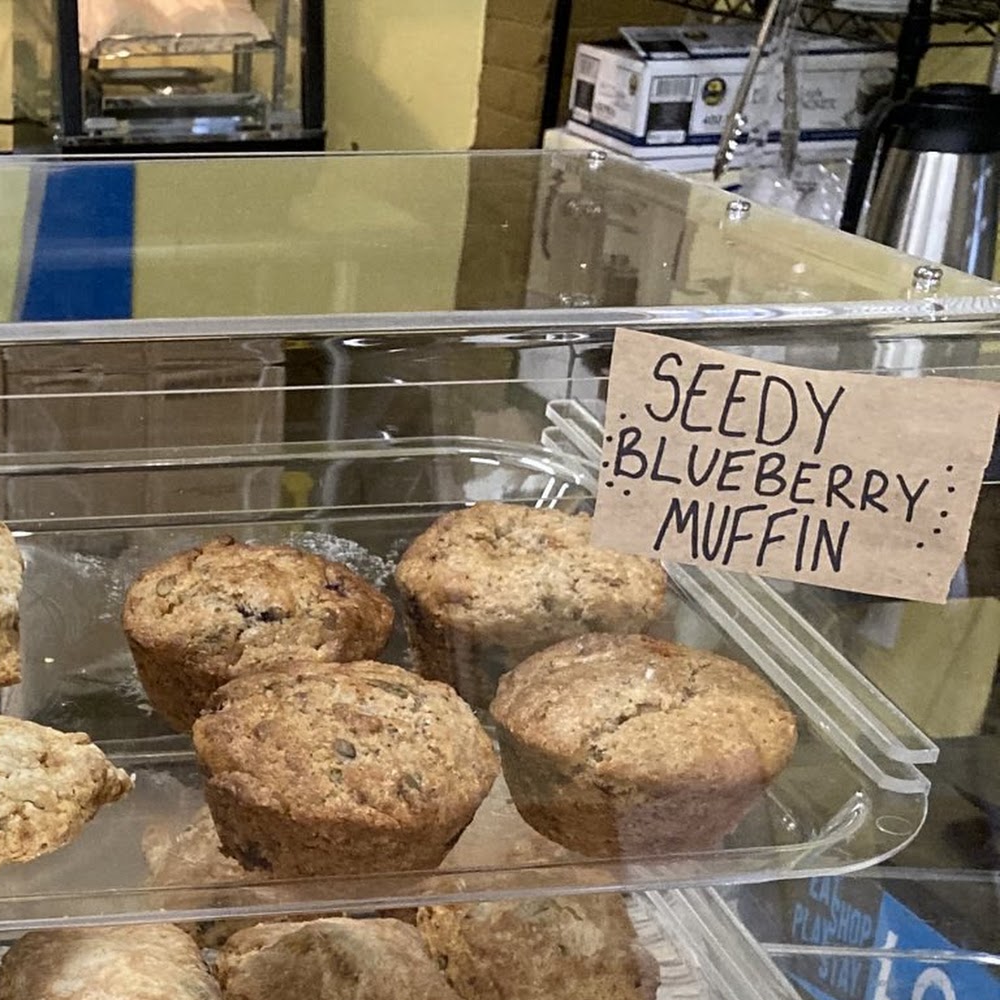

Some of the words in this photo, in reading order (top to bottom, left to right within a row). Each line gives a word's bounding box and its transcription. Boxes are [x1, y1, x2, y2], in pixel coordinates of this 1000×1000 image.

[645, 352, 845, 455] SEEDY
[613, 426, 930, 523] BLUEBERRY
[653, 497, 850, 573] MUFFIN
